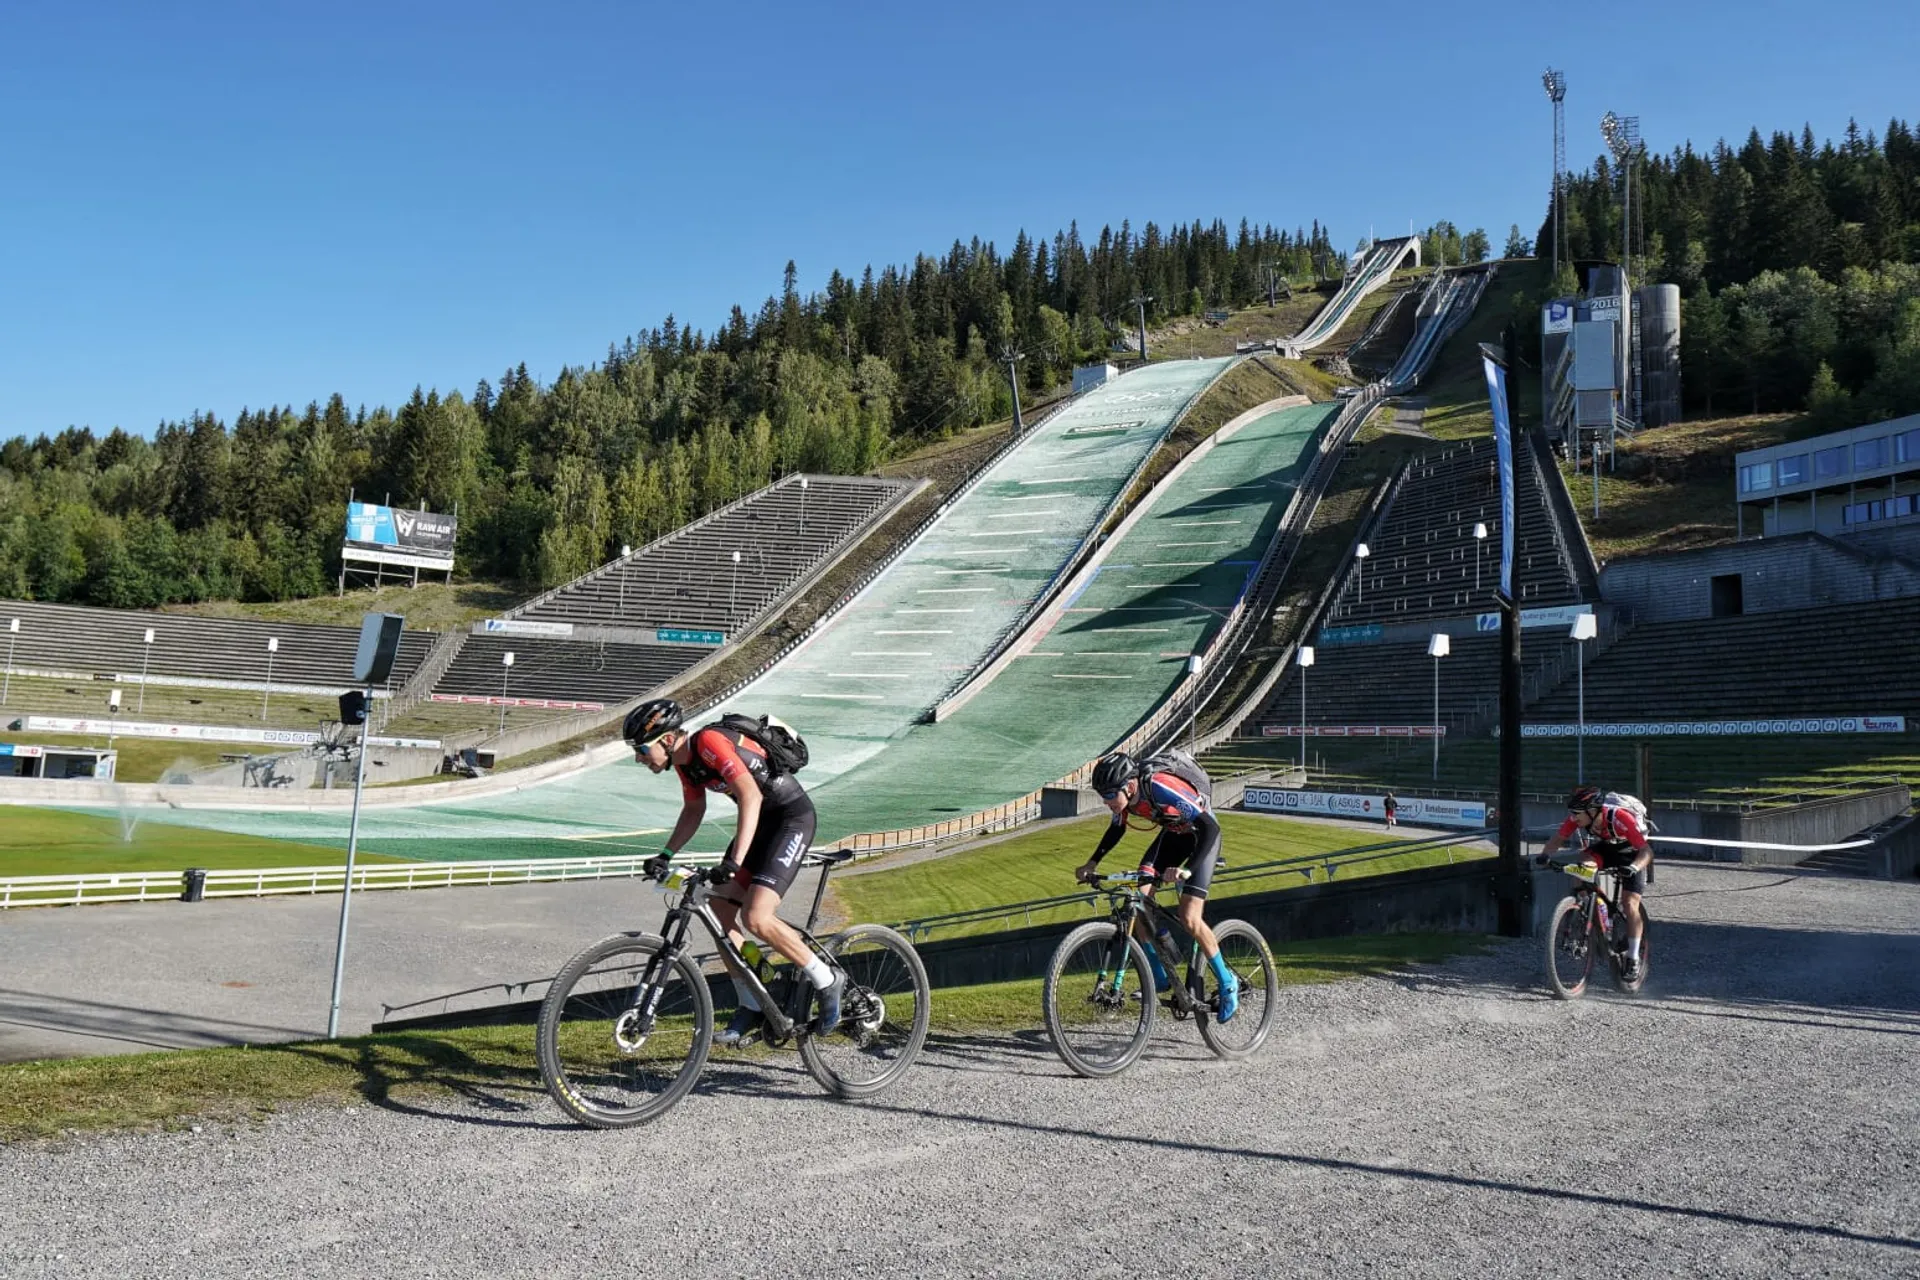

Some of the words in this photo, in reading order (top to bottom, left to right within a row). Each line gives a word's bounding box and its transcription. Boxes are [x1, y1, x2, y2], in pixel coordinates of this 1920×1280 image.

[1591, 298, 1620, 309] 2016
[416, 522, 437, 532] RAW
[437, 525, 451, 535] AIR
